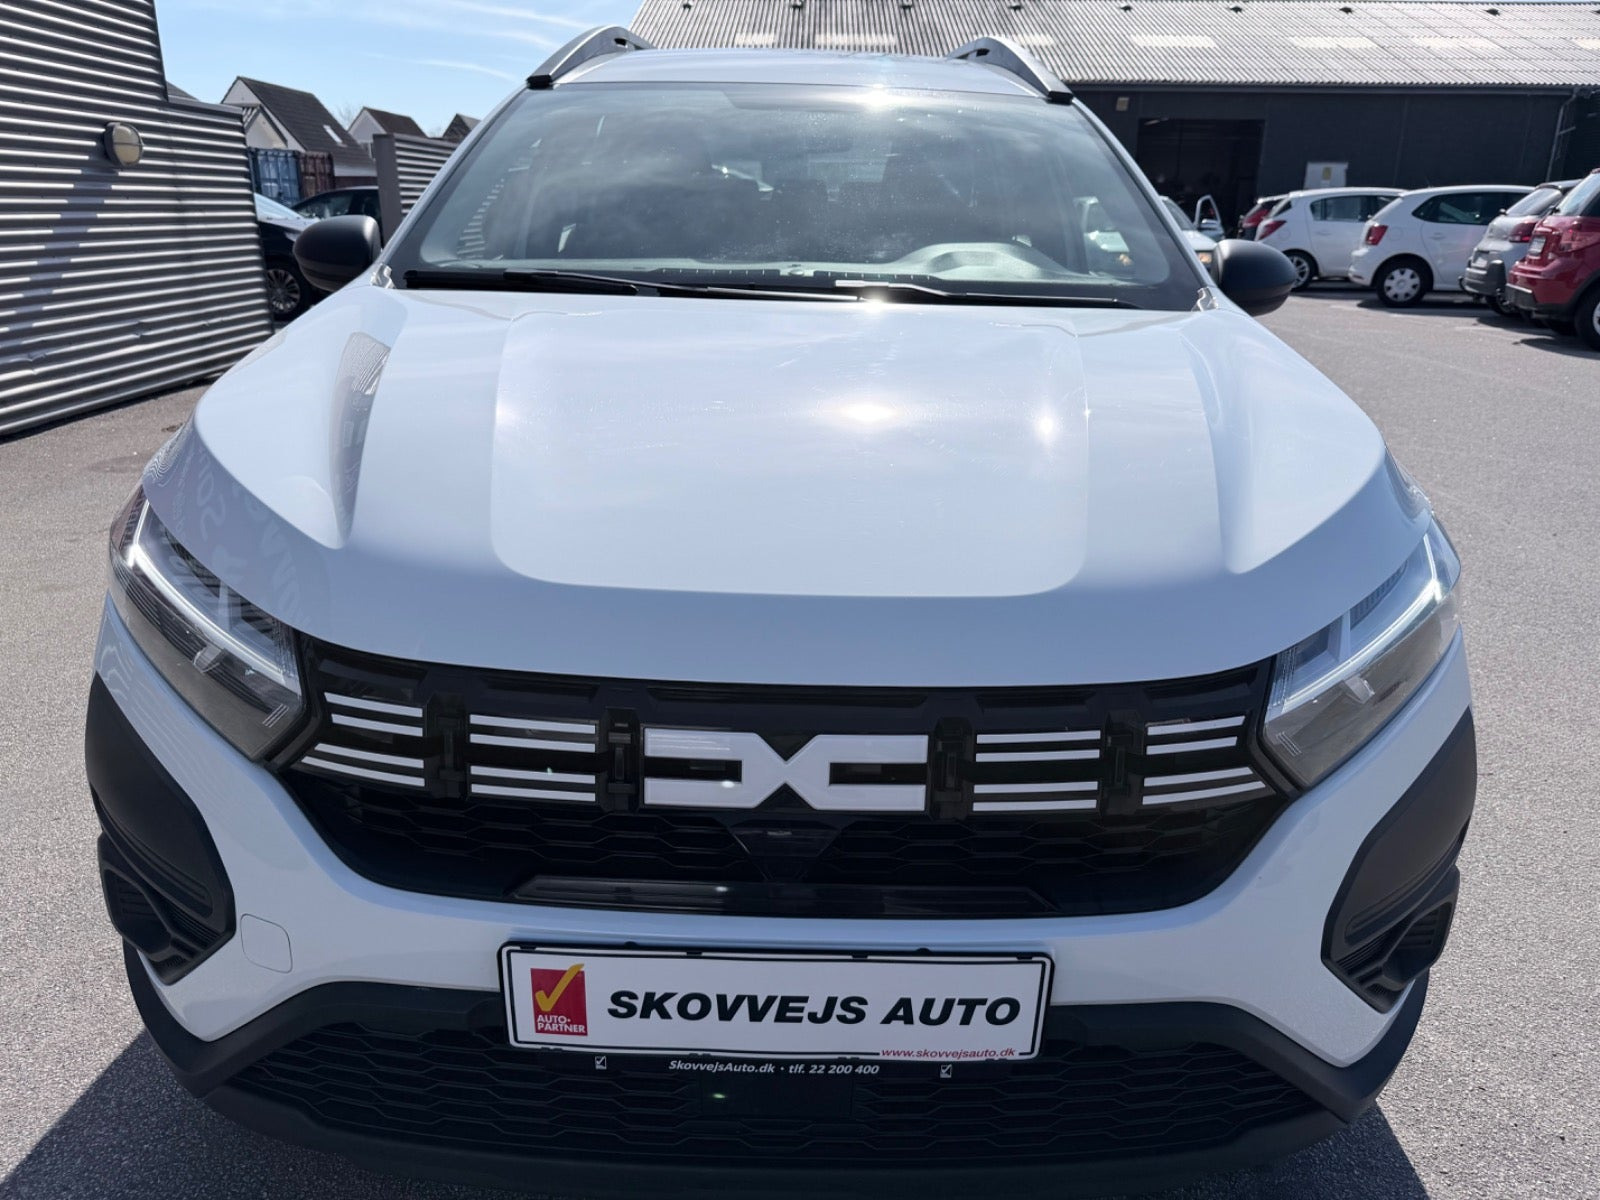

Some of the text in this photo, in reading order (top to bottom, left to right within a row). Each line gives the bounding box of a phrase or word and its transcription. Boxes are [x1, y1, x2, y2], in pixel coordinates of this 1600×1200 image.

[607, 990, 1021, 1026] SKOVVEJS AUTO
[537, 1022, 586, 1034] PARTNER
[881, 1048, 1016, 1060] www.skovvejsauto.dk
[668, 1060, 880, 1075] SkovvejsAuto.dk tlf. 22 200 400
